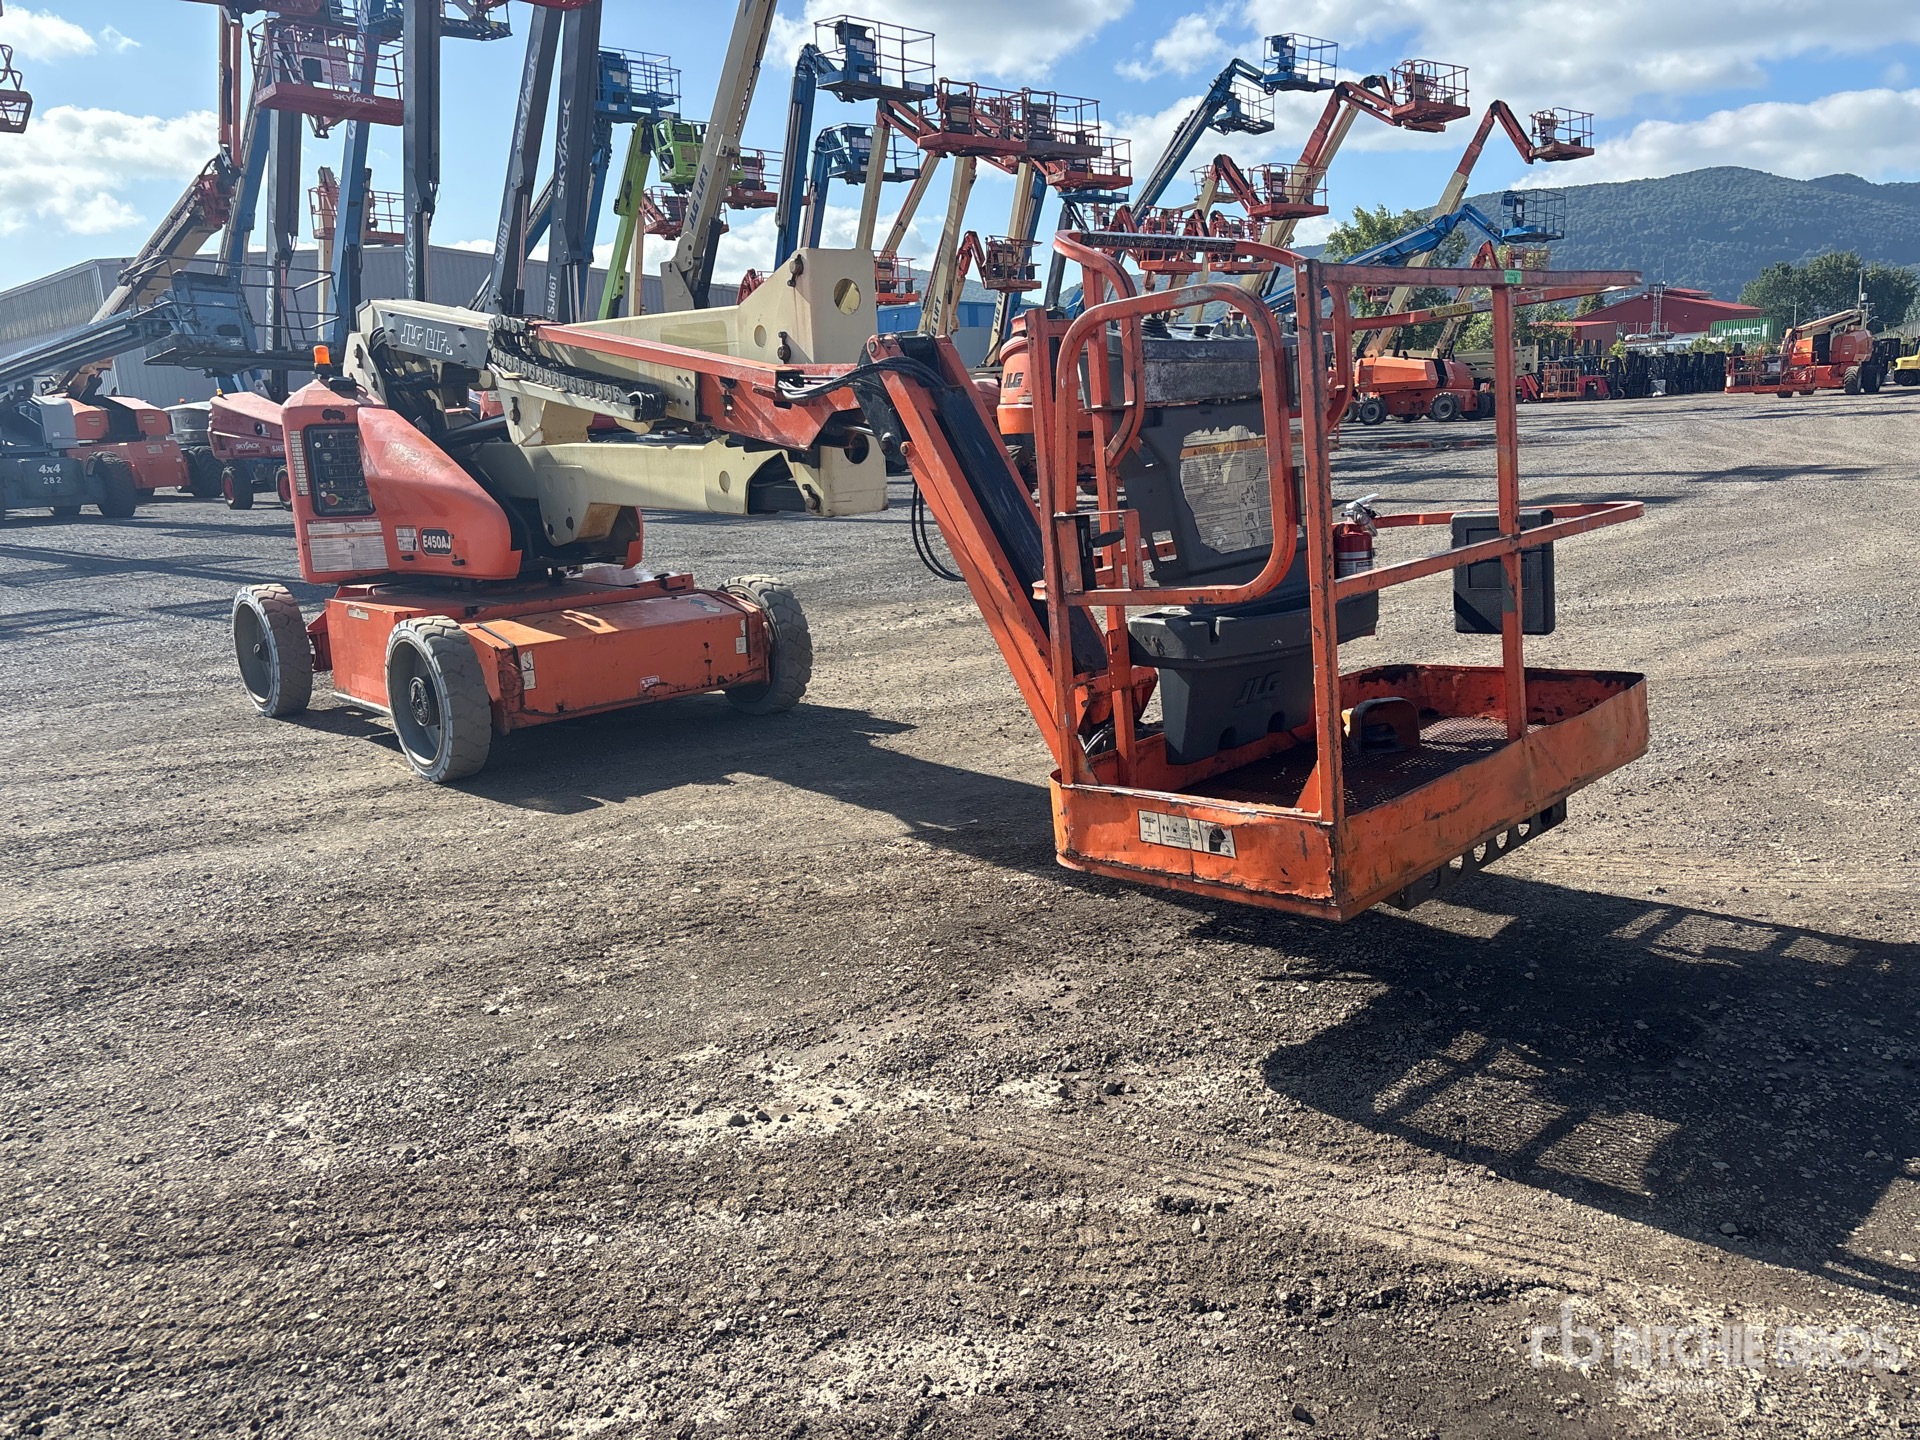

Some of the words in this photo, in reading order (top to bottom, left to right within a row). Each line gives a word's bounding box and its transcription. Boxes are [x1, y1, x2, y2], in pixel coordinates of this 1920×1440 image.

[332, 92, 378, 105] SKYJACK
[516, 55, 537, 150] SKYJACK
[557, 98, 571, 199] SKYJACK
[688, 199, 700, 230] JLG
[696, 164, 708, 201] LIFT
[495, 219, 510, 264] SJ86T
[405, 214, 414, 299] SKYJACK
[547, 273, 557, 314] SJ66T
[933, 297, 942, 324] LIFT
[1722, 326, 1761, 337] UASC
[1004, 371, 1024, 388] JLG
[236, 441, 261, 450] SKYJACK
[39, 463, 62, 474] 4x4
[42, 476, 62, 485] 282
[422, 534, 451, 550] E450AJ
[1233, 670, 1283, 709] JLG
